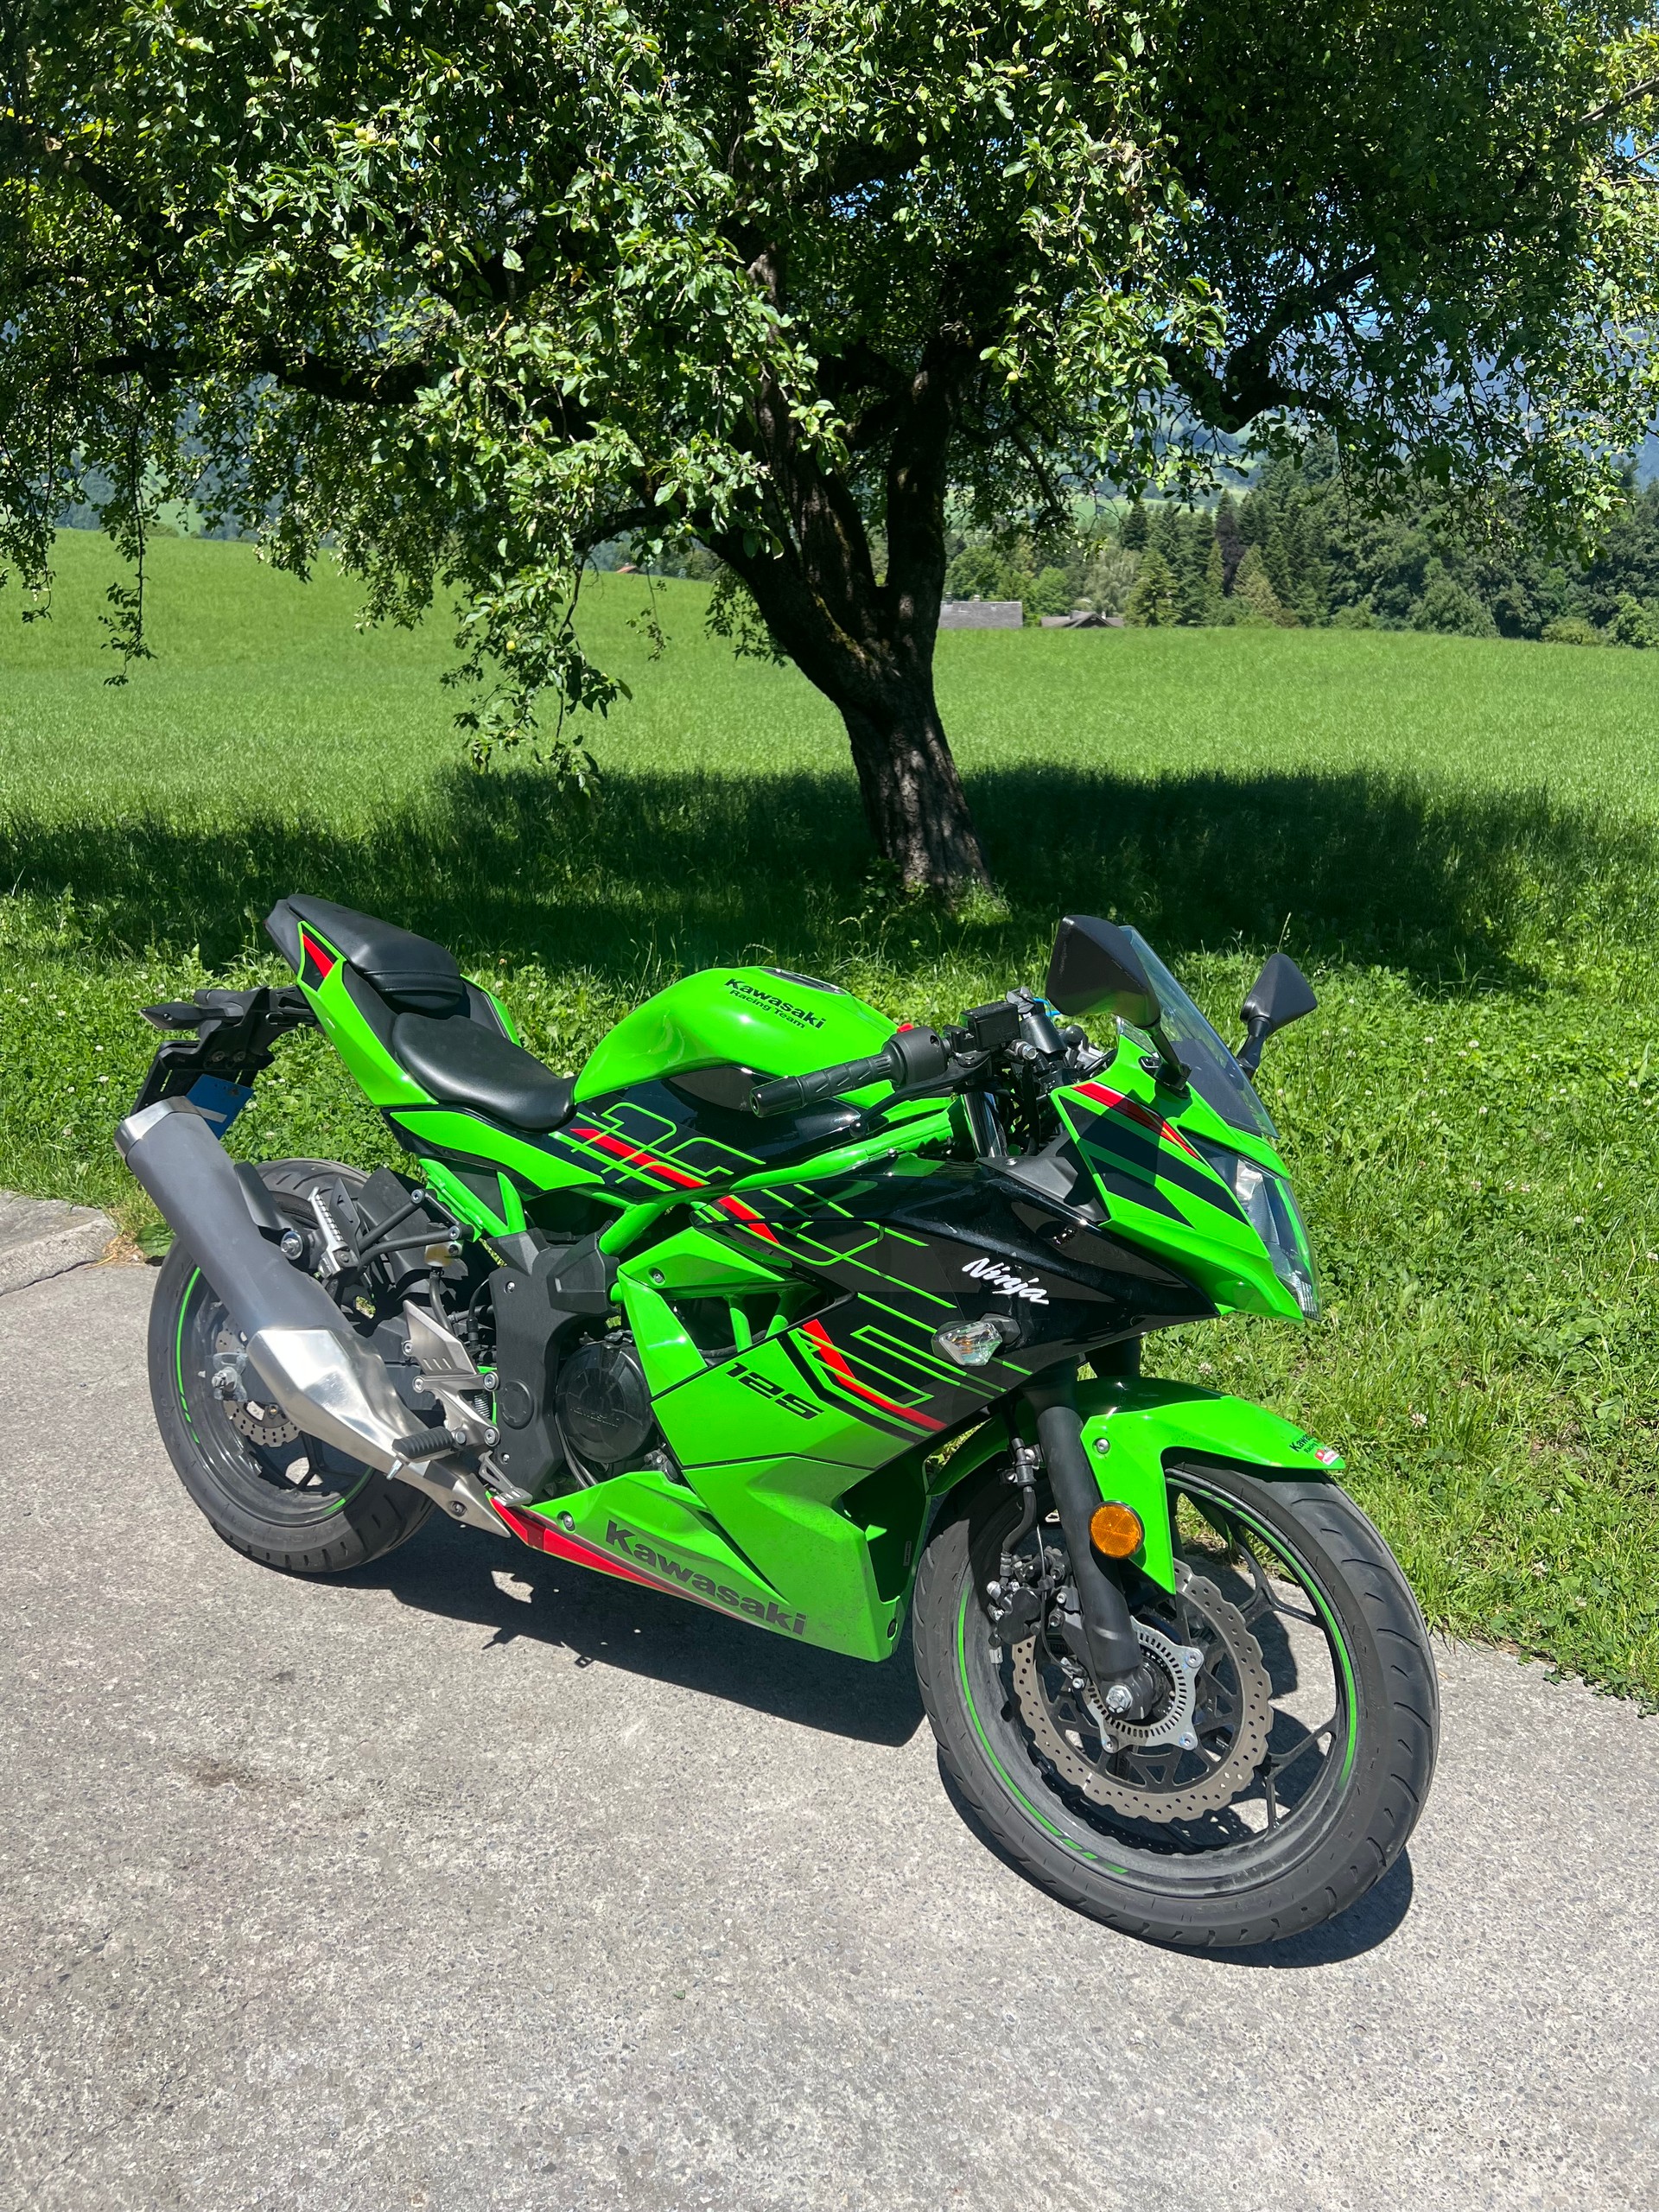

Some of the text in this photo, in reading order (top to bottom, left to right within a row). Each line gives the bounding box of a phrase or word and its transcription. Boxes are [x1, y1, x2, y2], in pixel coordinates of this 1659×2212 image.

[724, 978, 826, 1029] Kawasaki
[729, 989, 805, 1028] Racing Team
[962, 1258, 1049, 1305] Ninja
[726, 1362, 825, 1420] 125
[606, 1519, 808, 1636] Kawasaki
